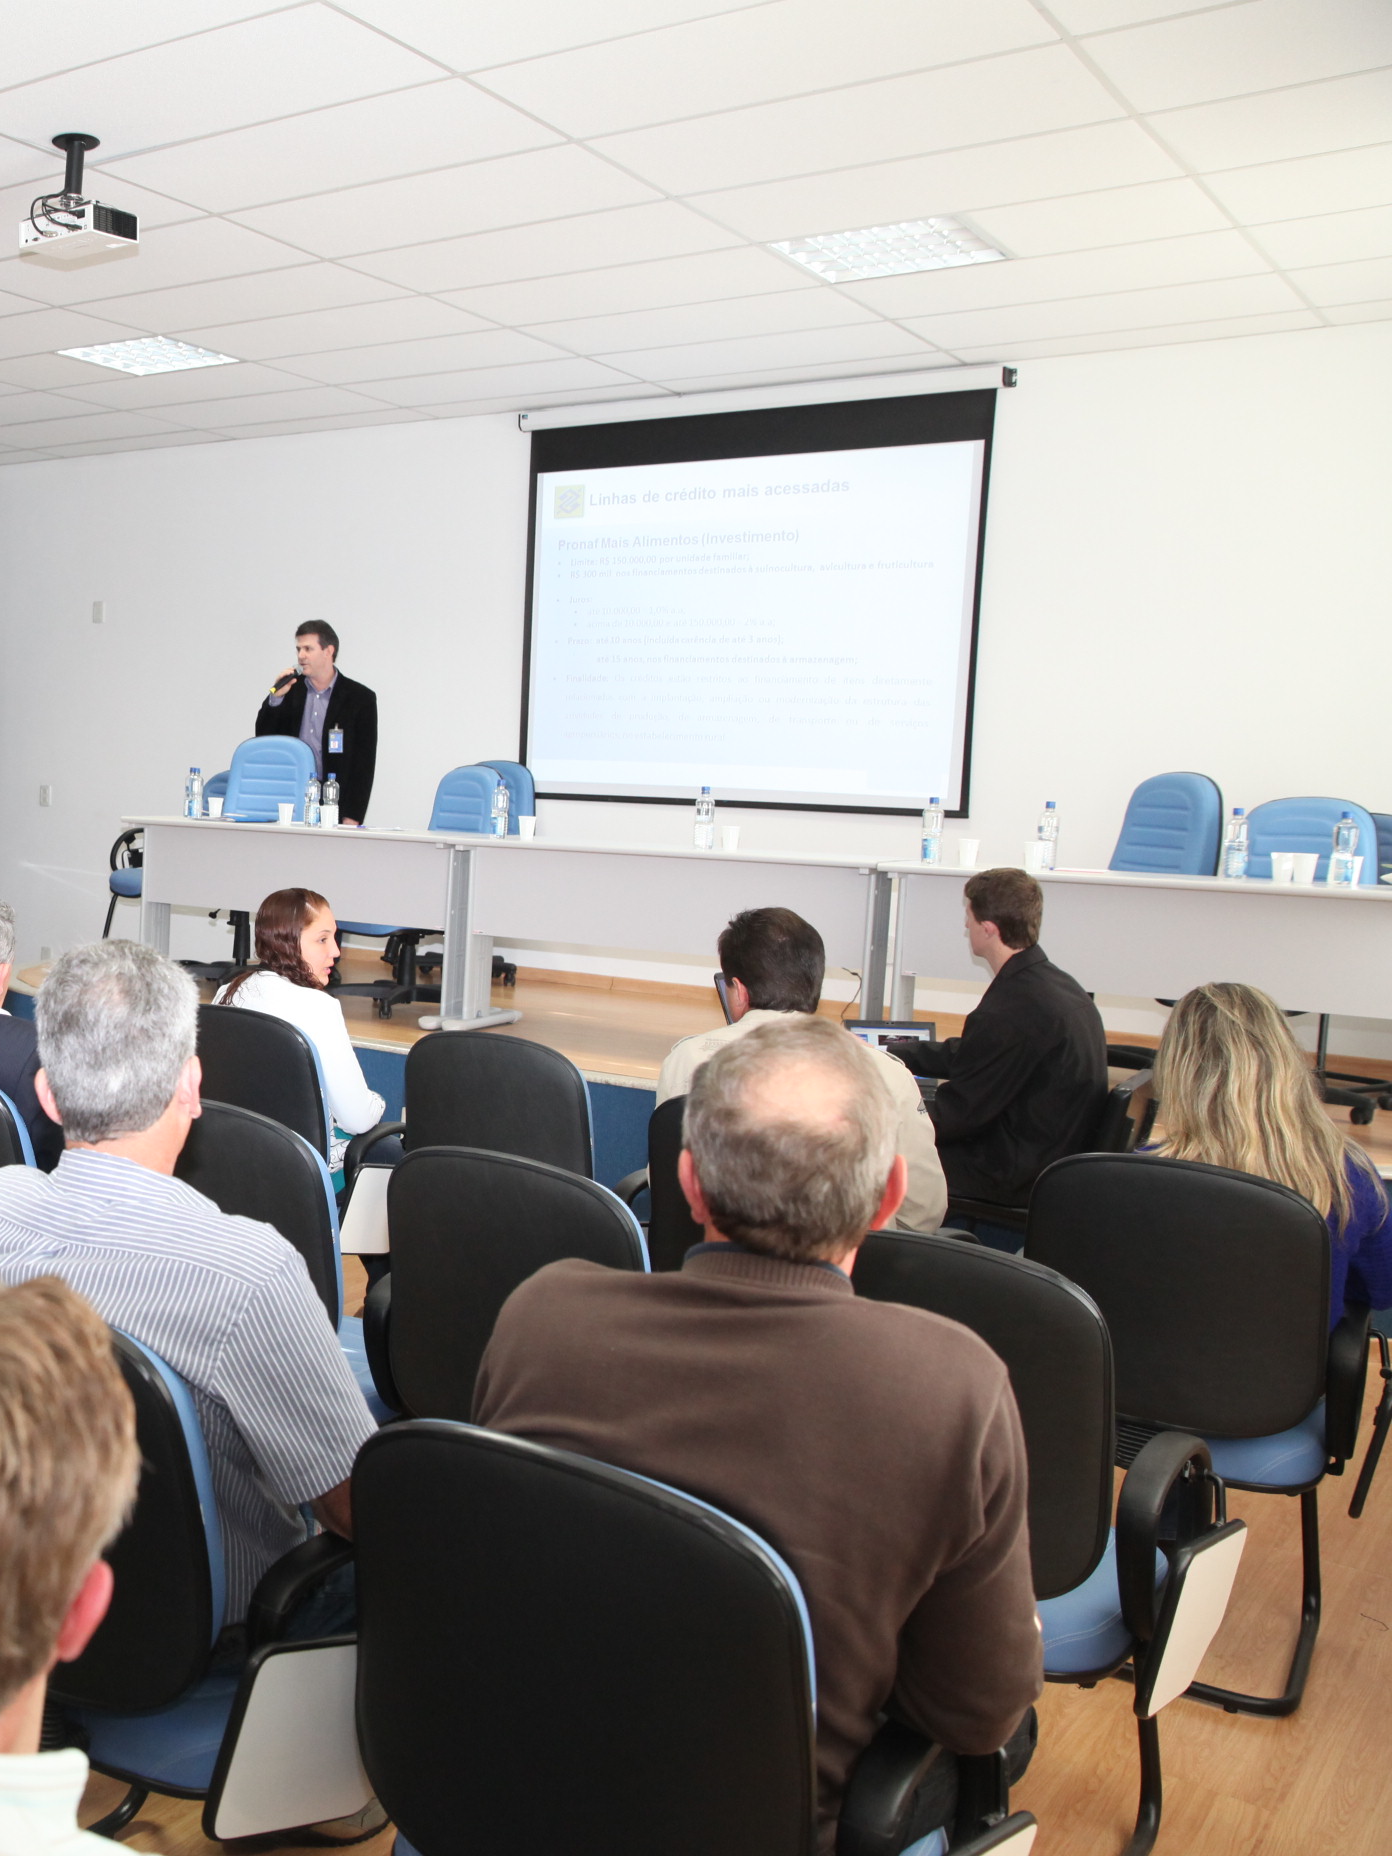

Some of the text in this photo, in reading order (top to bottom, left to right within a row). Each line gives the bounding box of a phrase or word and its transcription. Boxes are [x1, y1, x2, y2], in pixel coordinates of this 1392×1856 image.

[590, 479, 850, 506] Linhas de crédito mais acessadas
[558, 528, 800, 550] Pronaf Mais Alimentos (Investimento)
